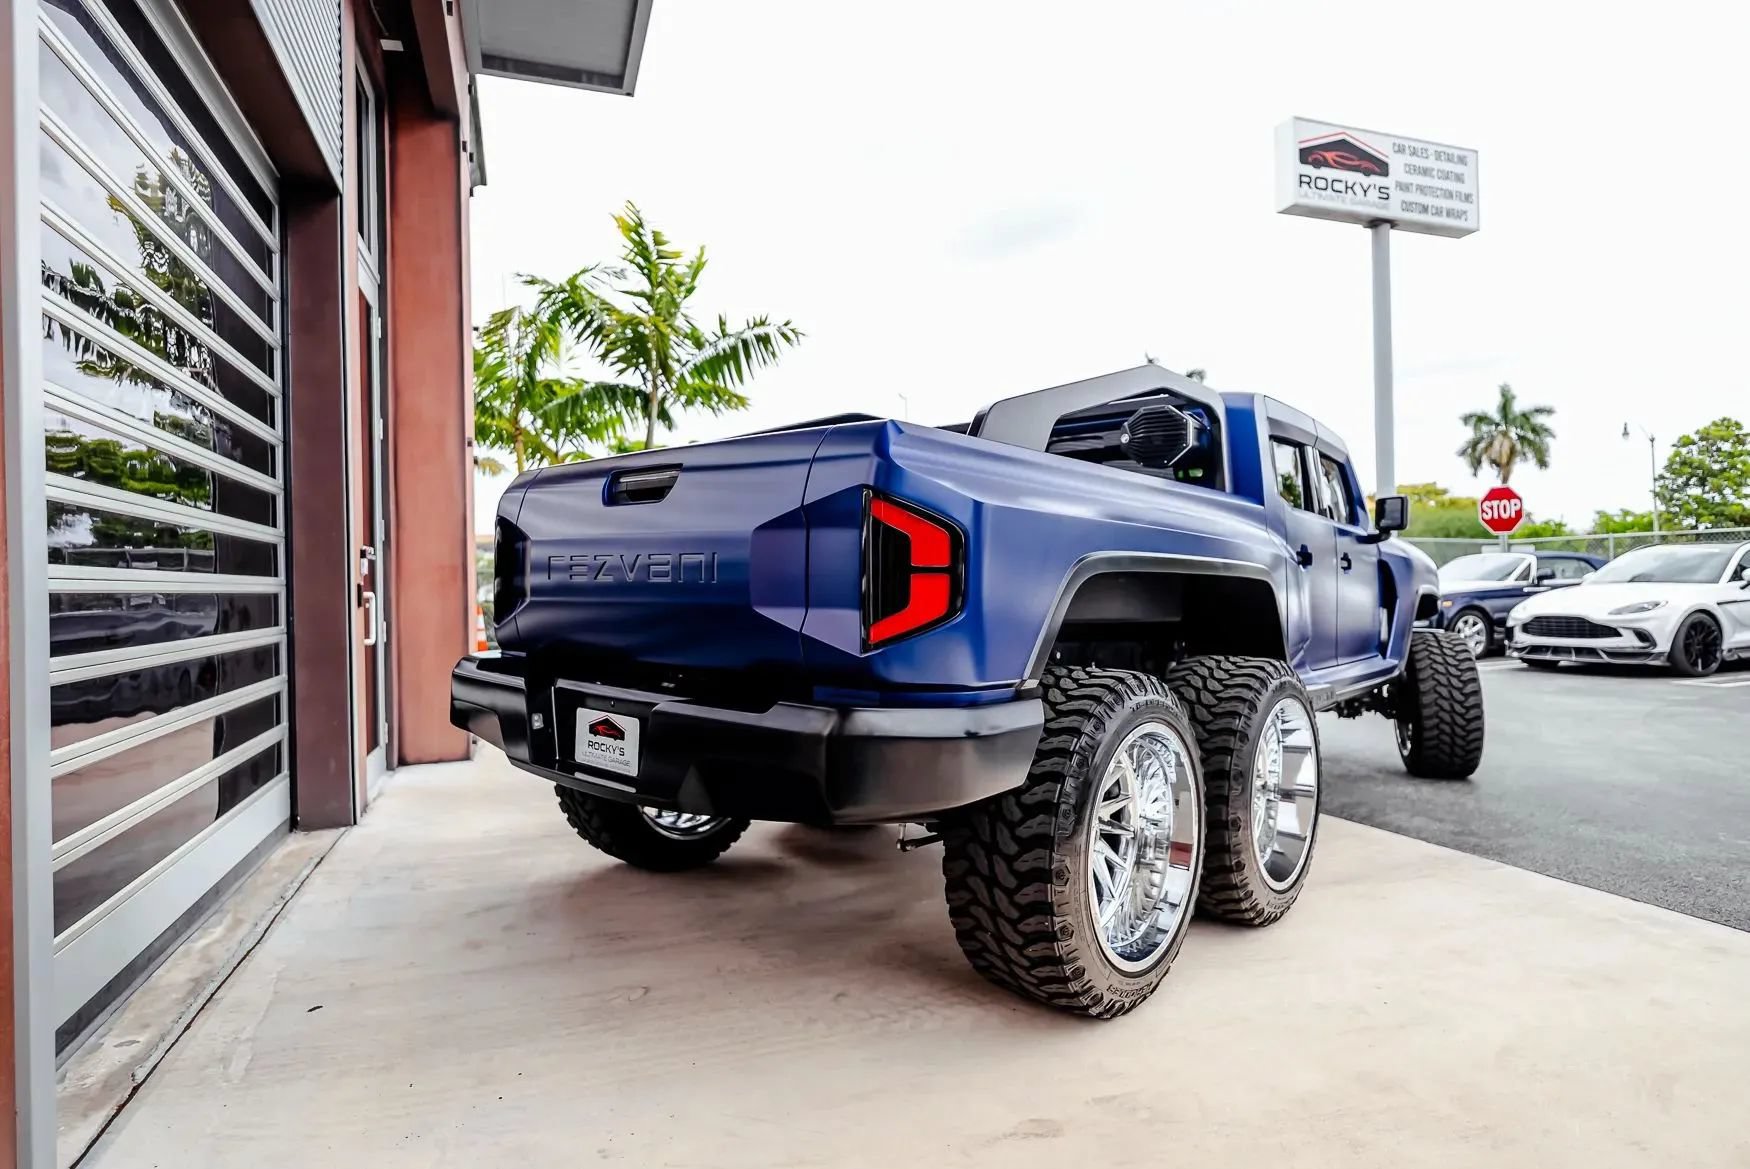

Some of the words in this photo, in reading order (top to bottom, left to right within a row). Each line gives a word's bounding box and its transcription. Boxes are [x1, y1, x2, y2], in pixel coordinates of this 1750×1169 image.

[1392, 142, 1406, 155] CAR
[1408, 144, 1429, 159] SALES
[1434, 149, 1468, 166] DETAILING
[1404, 162, 1435, 179] CERAMIC
[1437, 168, 1465, 184] COATING
[1299, 174, 1390, 201] ROCKY'S
[1395, 180, 1414, 193] PAINT
[1415, 183, 1454, 201] PROTECTION
[1455, 190, 1474, 204] FILMS
[1401, 199, 1429, 215] CUSTOM
[1430, 204, 1444, 218] CAR
[1446, 207, 1468, 222] WRAPS
[1482, 498, 1521, 521] STOP
[588, 740, 625, 757] ROCKY'S
[608, 756, 631, 767] GARAGE
